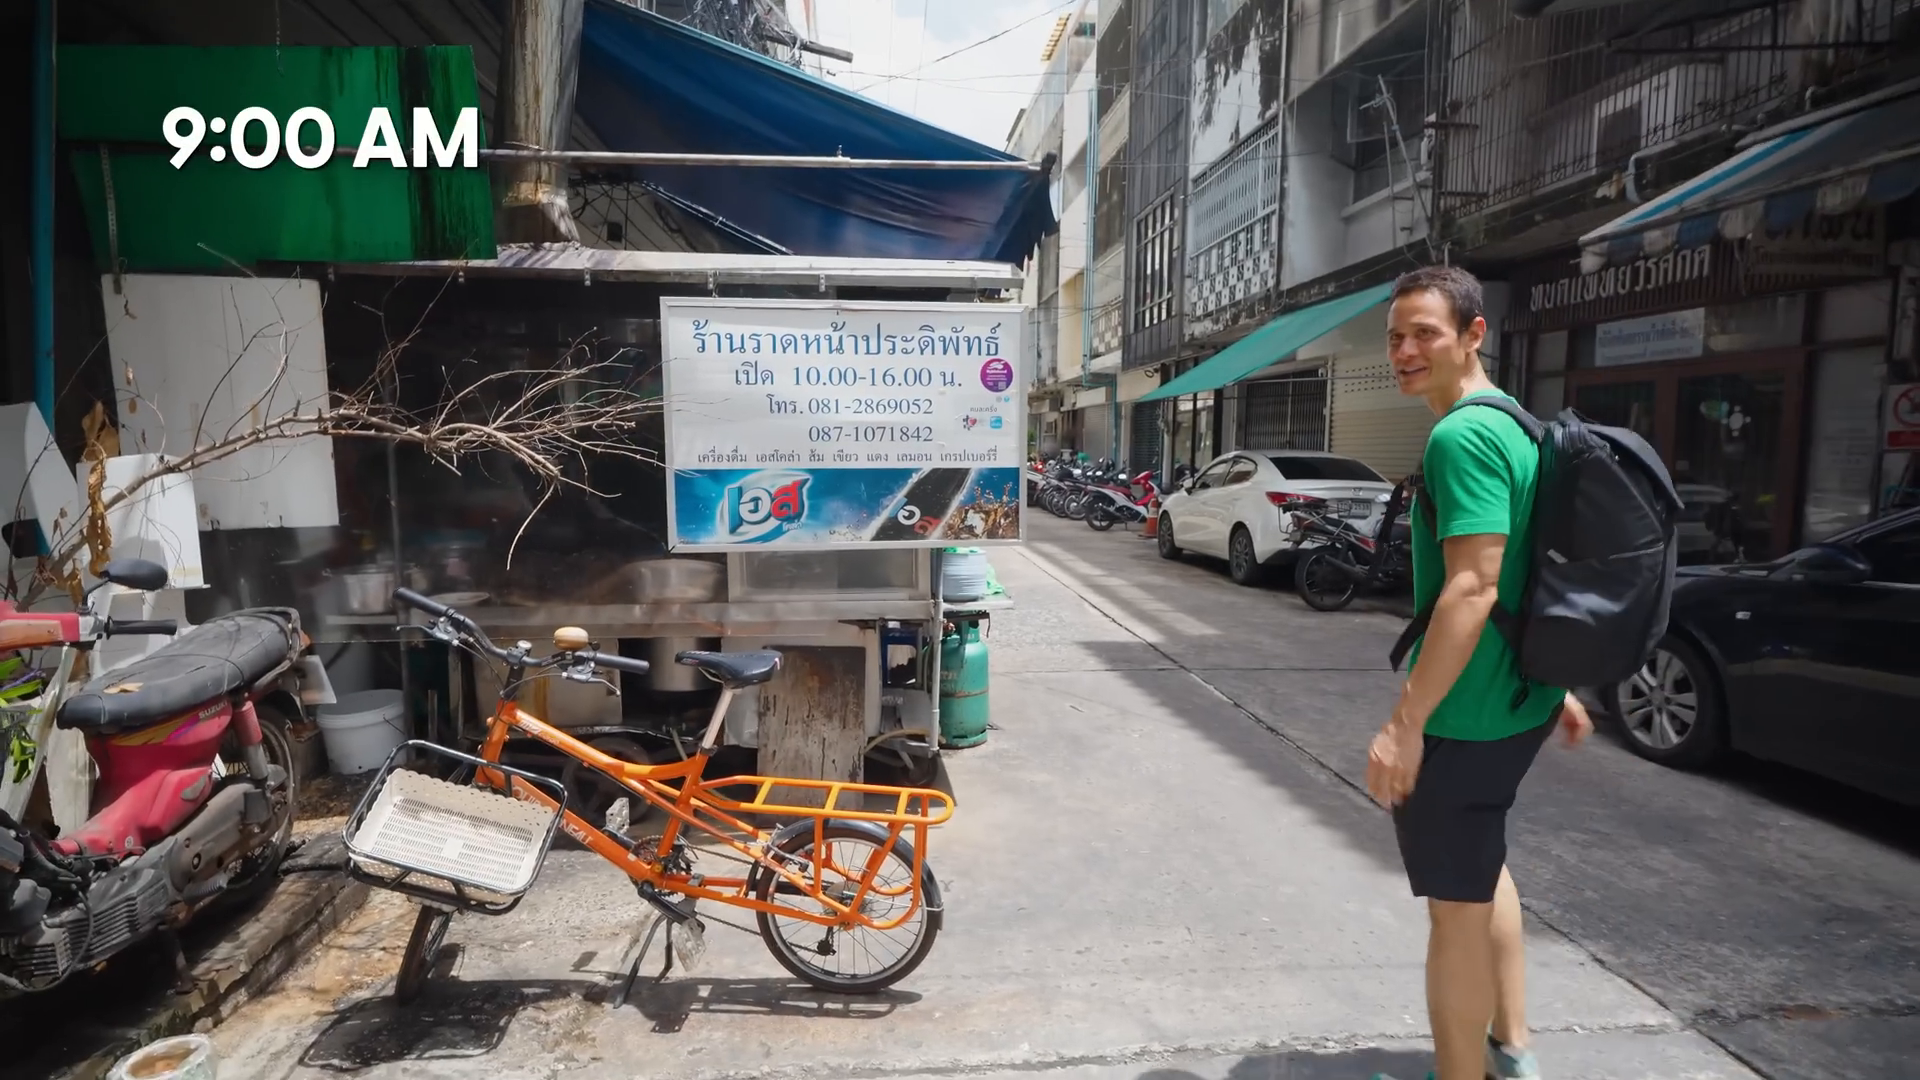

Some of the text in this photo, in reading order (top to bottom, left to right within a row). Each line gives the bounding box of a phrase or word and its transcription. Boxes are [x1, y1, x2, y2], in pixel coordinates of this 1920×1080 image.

[692, 319, 1002, 357] ร้านราดหน้าประดิพัทธ์
[735, 361, 775, 386] เปิด
[793, 366, 933, 387] 10.00-16.00
[940, 370, 962, 387] น.
[808, 397, 934, 415] 081-2869052
[808, 425, 934, 443] 087-1071842
[697, 446, 747, 462] เครื่องดื่ม
[756, 448, 801, 462] เอสโคล่า
[808, 448, 825, 462] ส้ม
[832, 448, 859, 462] เขียว
[866, 453, 889, 462] แดง
[896, 453, 933, 462] เลมอน
[728, 477, 809, 534] เอส
[198, 700, 228, 719] SUZUKI
